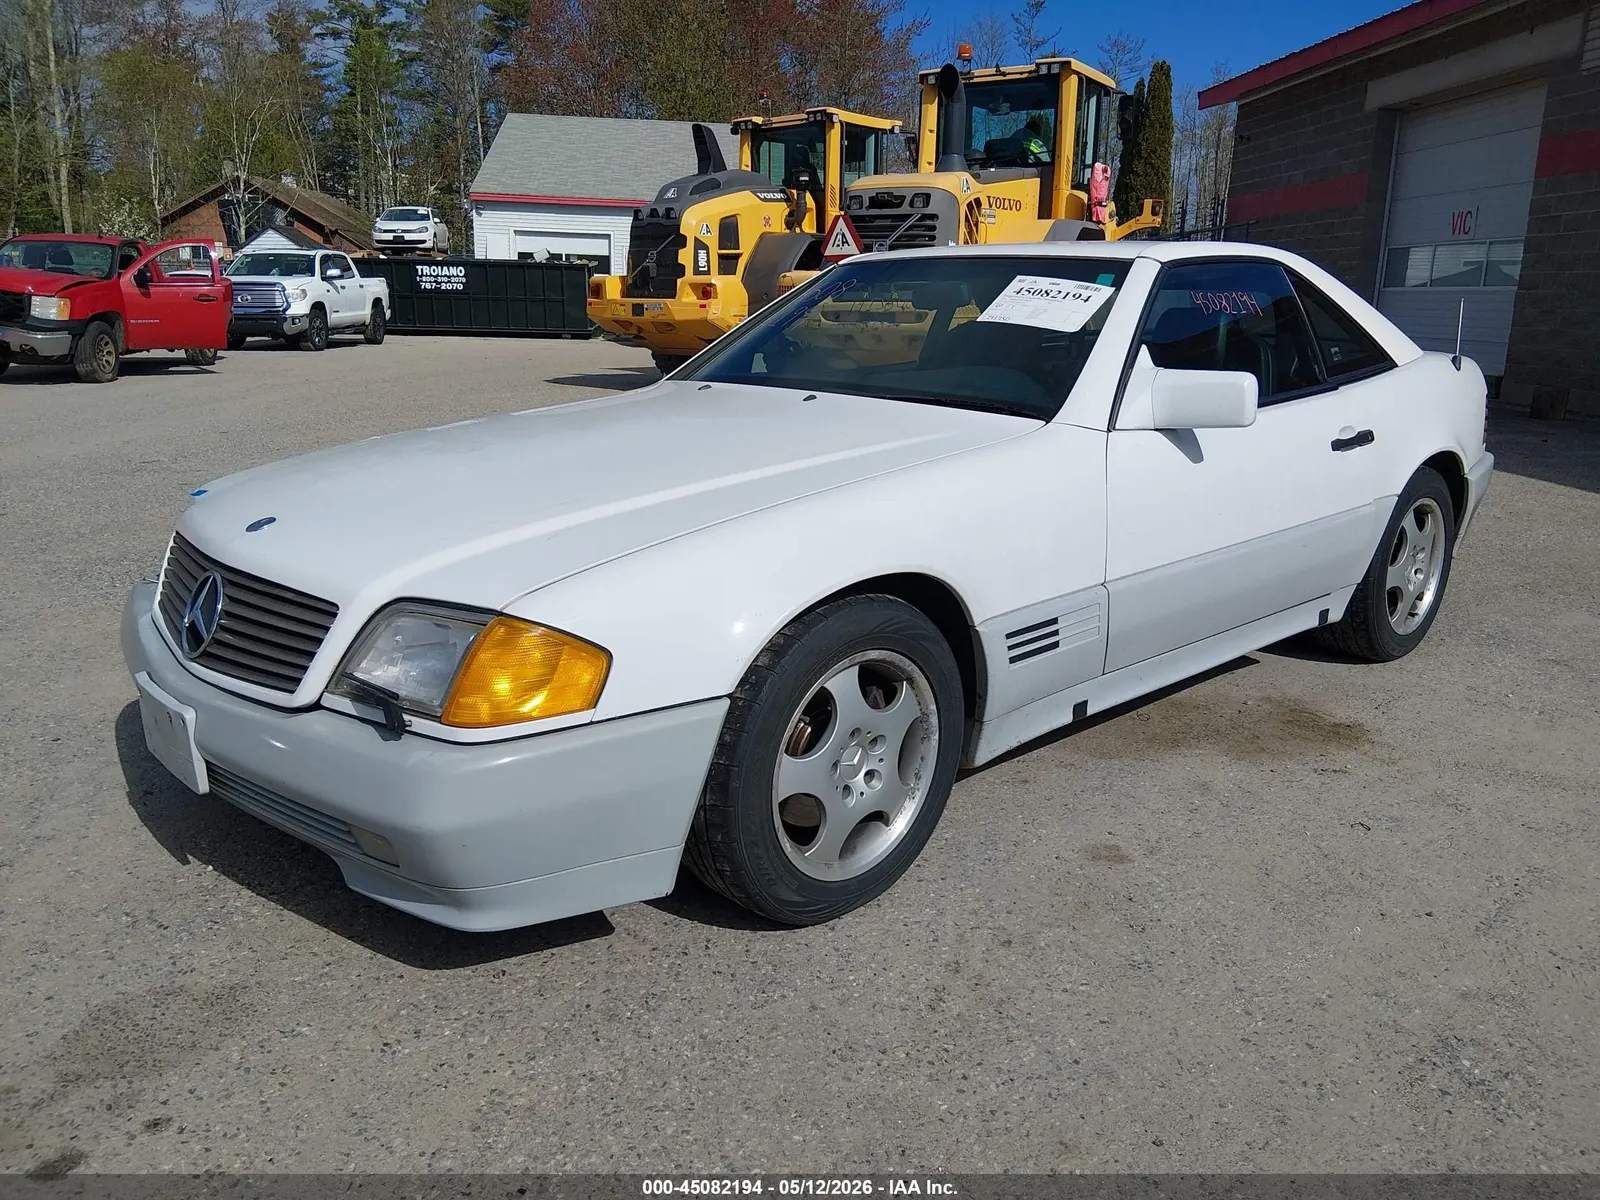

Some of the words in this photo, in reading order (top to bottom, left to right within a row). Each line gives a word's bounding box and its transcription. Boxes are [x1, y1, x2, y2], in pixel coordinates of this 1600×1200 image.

[987, 196, 1021, 211] VOLVO
[416, 266, 465, 276] TROIANO
[420, 282, 463, 290] 767-2070
[1012, 286, 1093, 305] 45082194
[1190, 291, 1263, 317] 45082194
